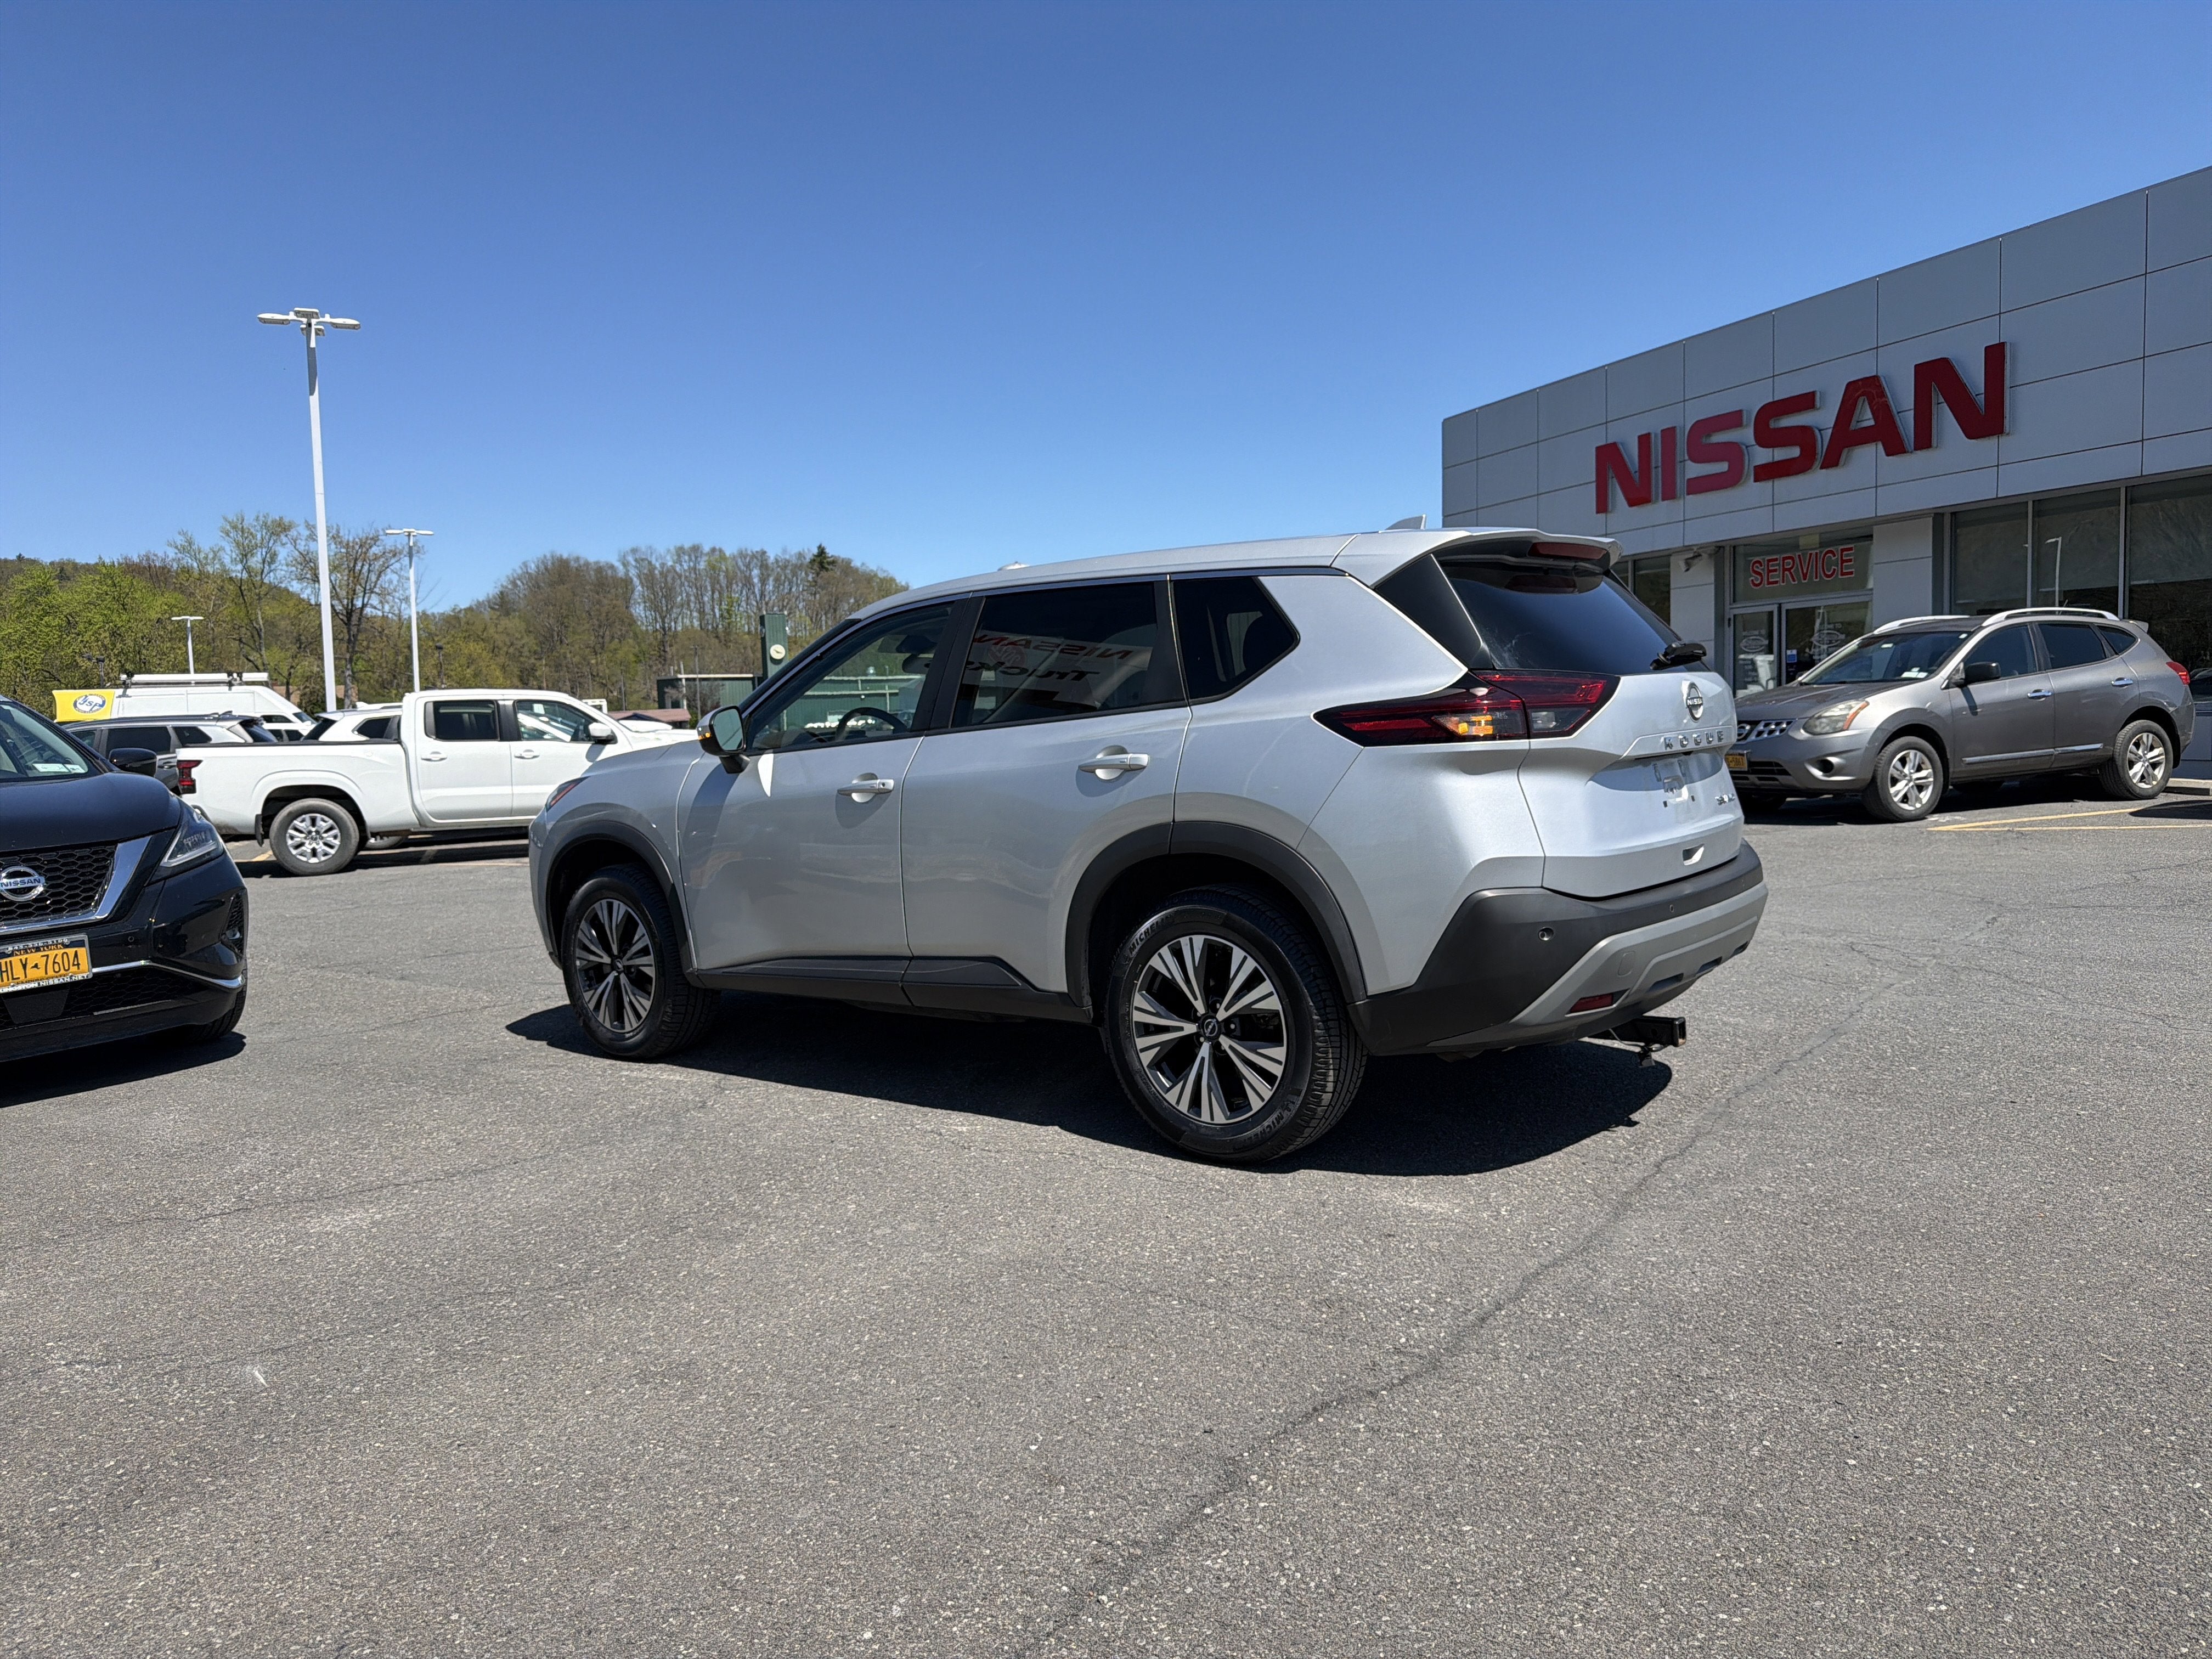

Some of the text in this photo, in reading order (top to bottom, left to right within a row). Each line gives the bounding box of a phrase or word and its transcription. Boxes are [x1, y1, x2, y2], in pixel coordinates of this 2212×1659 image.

[1596, 342, 2008, 514] NISSAN
[1749, 546, 1855, 589] SERVICE
[1661, 731, 1724, 751] ROGUE
[1, 878, 41, 888] NISSAN
[40, 943, 64, 951] YORK
[41, 950, 81, 975] 7604
[1238, 1112, 1284, 1144] MICHEL
